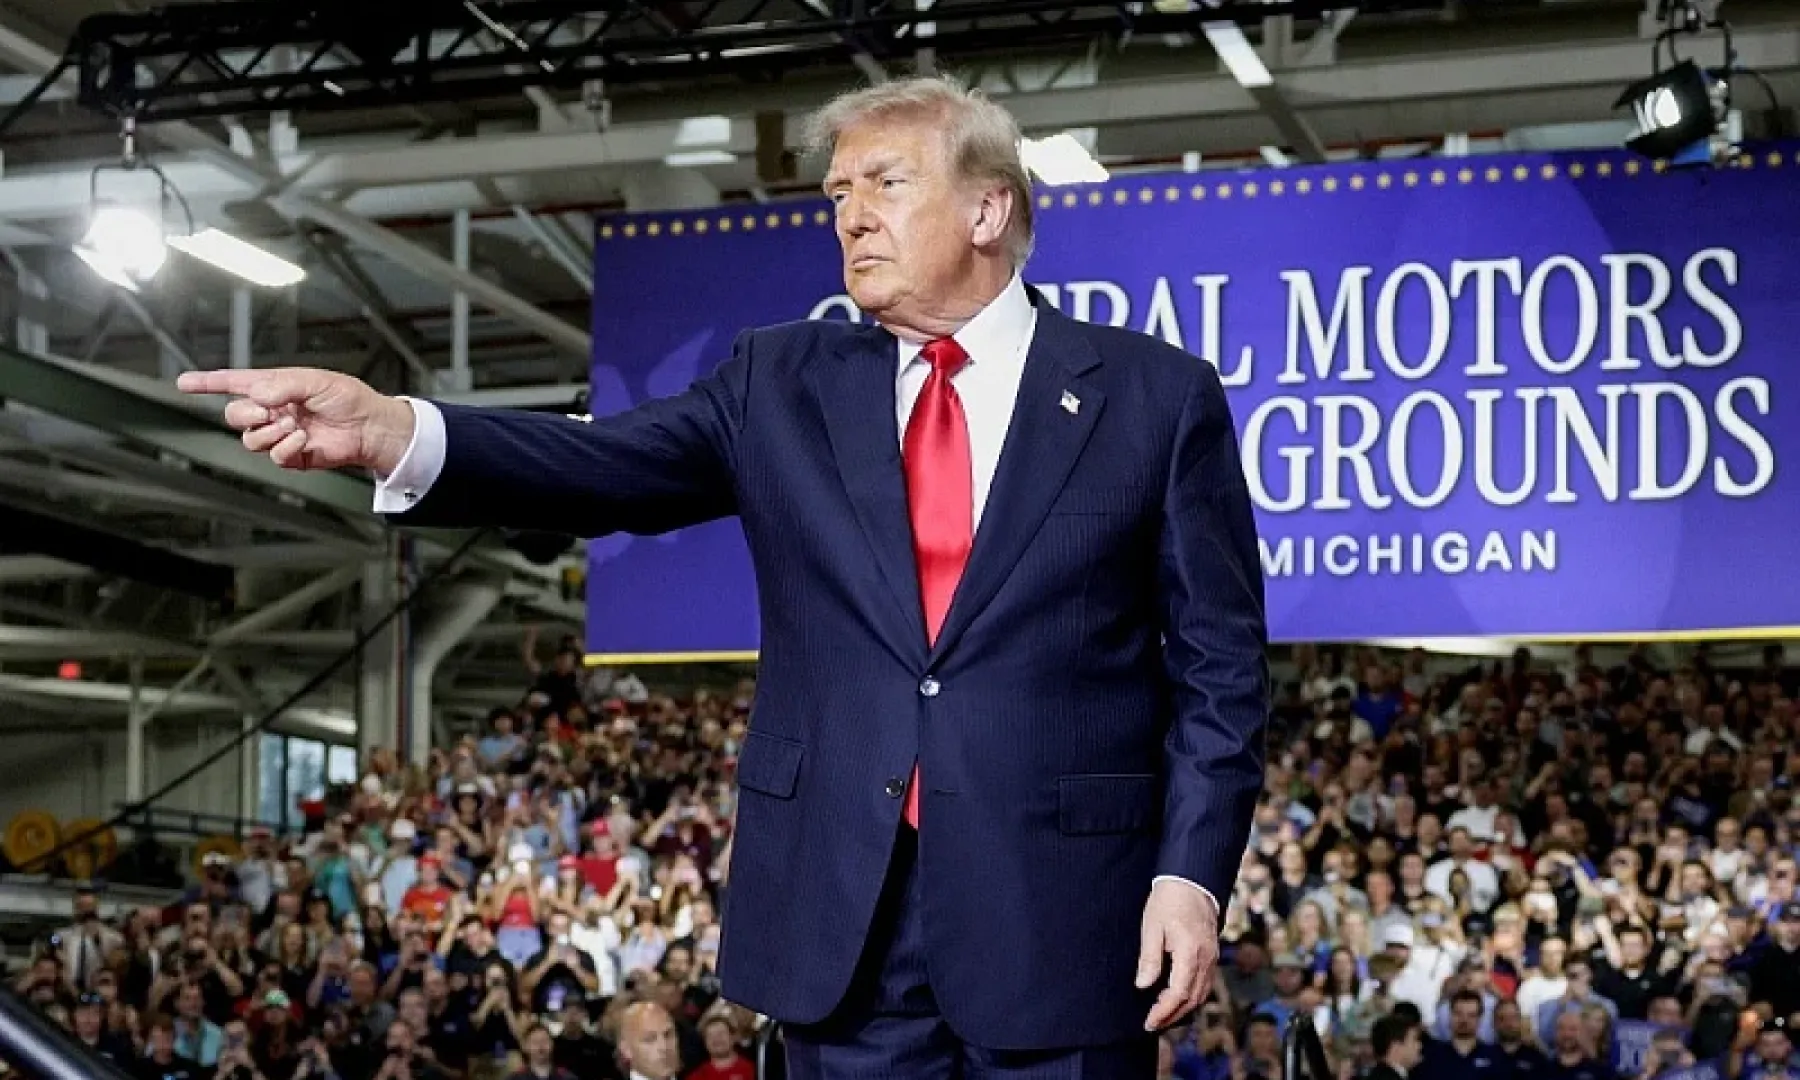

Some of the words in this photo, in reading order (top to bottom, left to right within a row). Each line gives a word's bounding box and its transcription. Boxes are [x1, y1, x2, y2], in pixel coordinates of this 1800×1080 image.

[1277, 248, 1742, 384] MOTORS
[1241, 376, 1774, 512] GROUNDS
[1257, 530, 1557, 577] MICHIGAN
